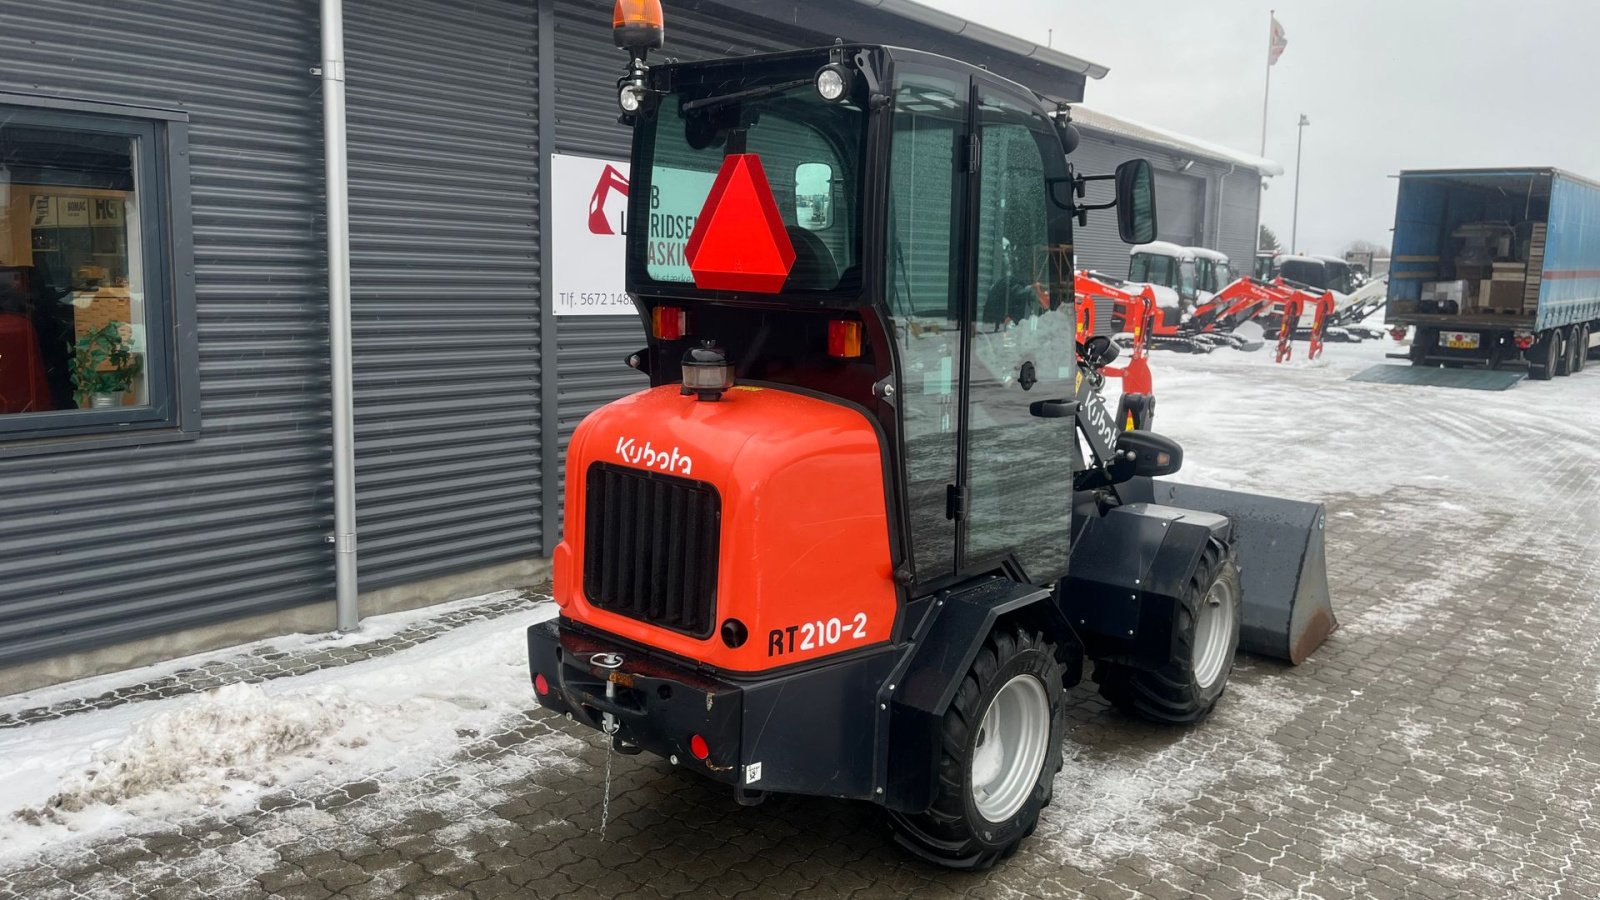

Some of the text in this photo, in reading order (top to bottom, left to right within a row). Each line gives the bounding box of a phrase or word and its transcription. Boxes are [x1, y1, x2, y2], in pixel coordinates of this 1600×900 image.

[559, 292, 578, 308] Tlf.
[580, 292, 607, 305] 5672
[615, 436, 692, 475] Kubota
[768, 612, 867, 657] RT210-2
